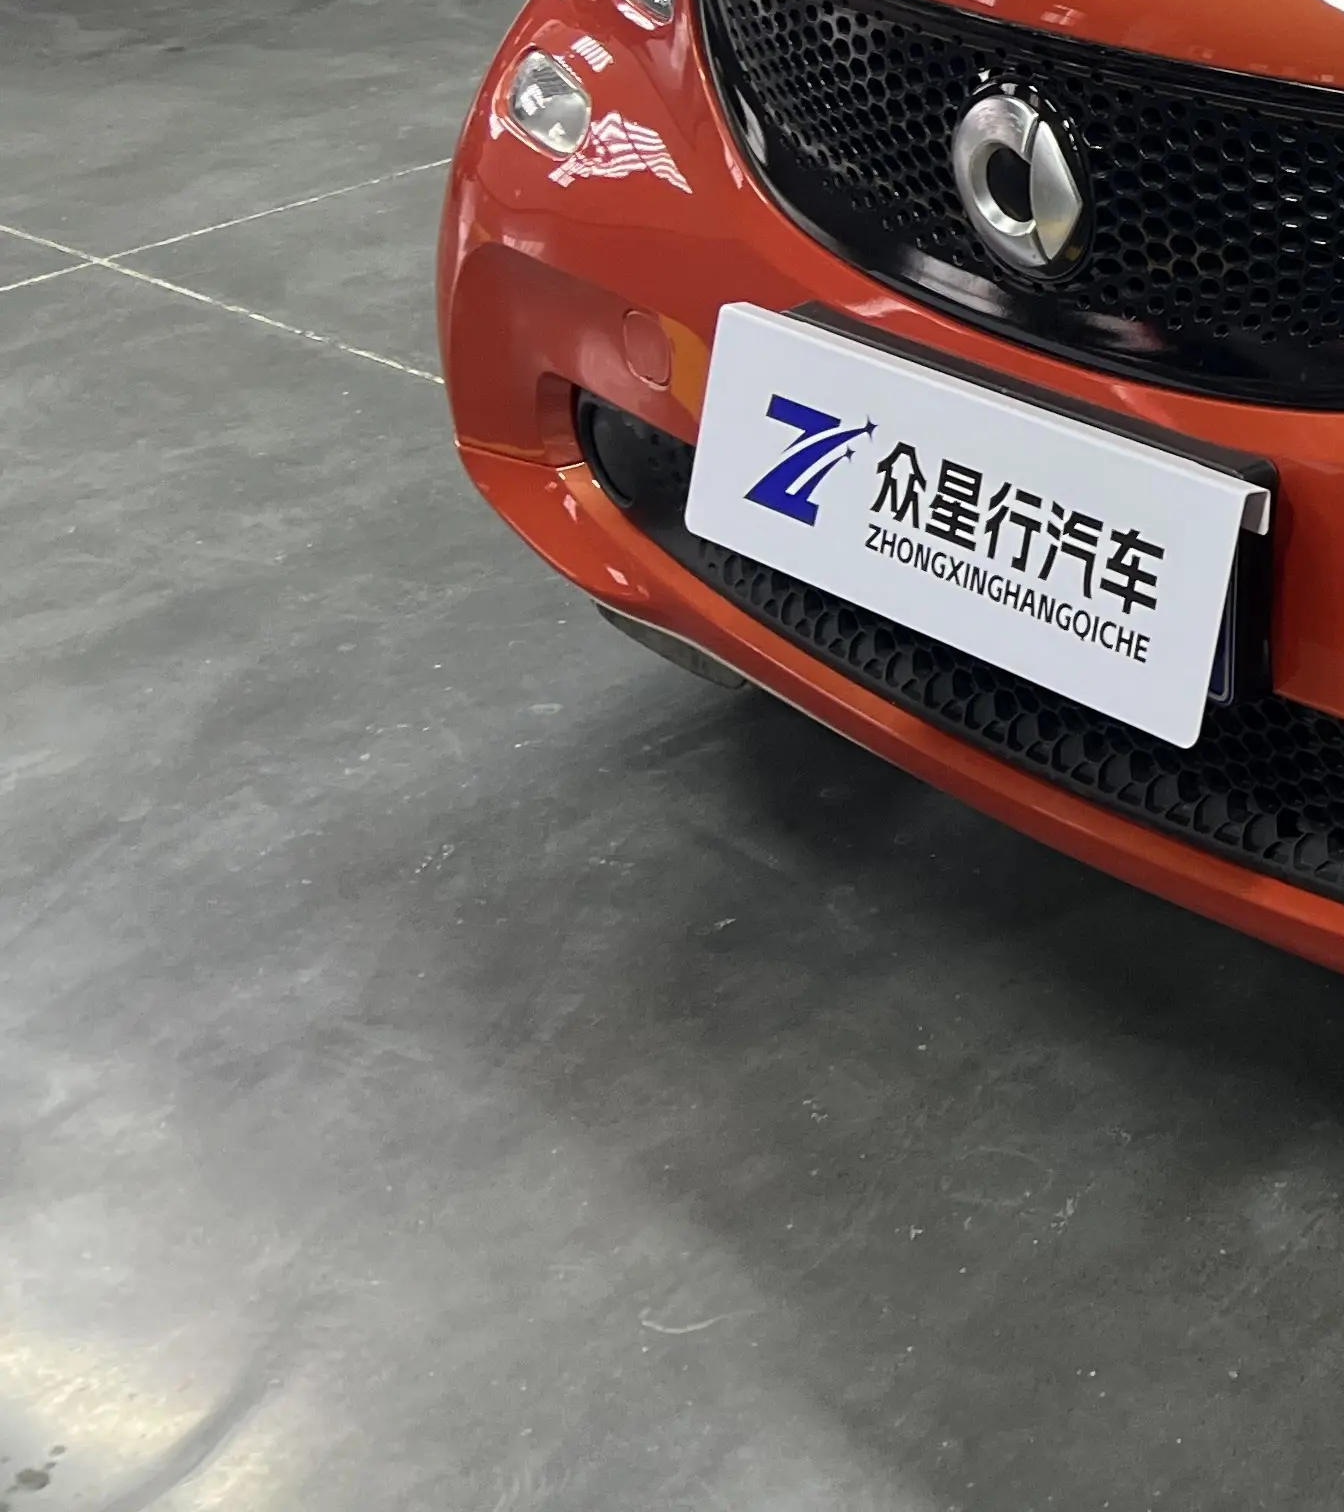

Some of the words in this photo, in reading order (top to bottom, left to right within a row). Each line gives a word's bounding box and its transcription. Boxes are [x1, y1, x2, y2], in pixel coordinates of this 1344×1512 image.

[865, 524, 1152, 663] ZHONGXINGHANGQICHE
[869, 441, 1165, 615] 众星行汽车
